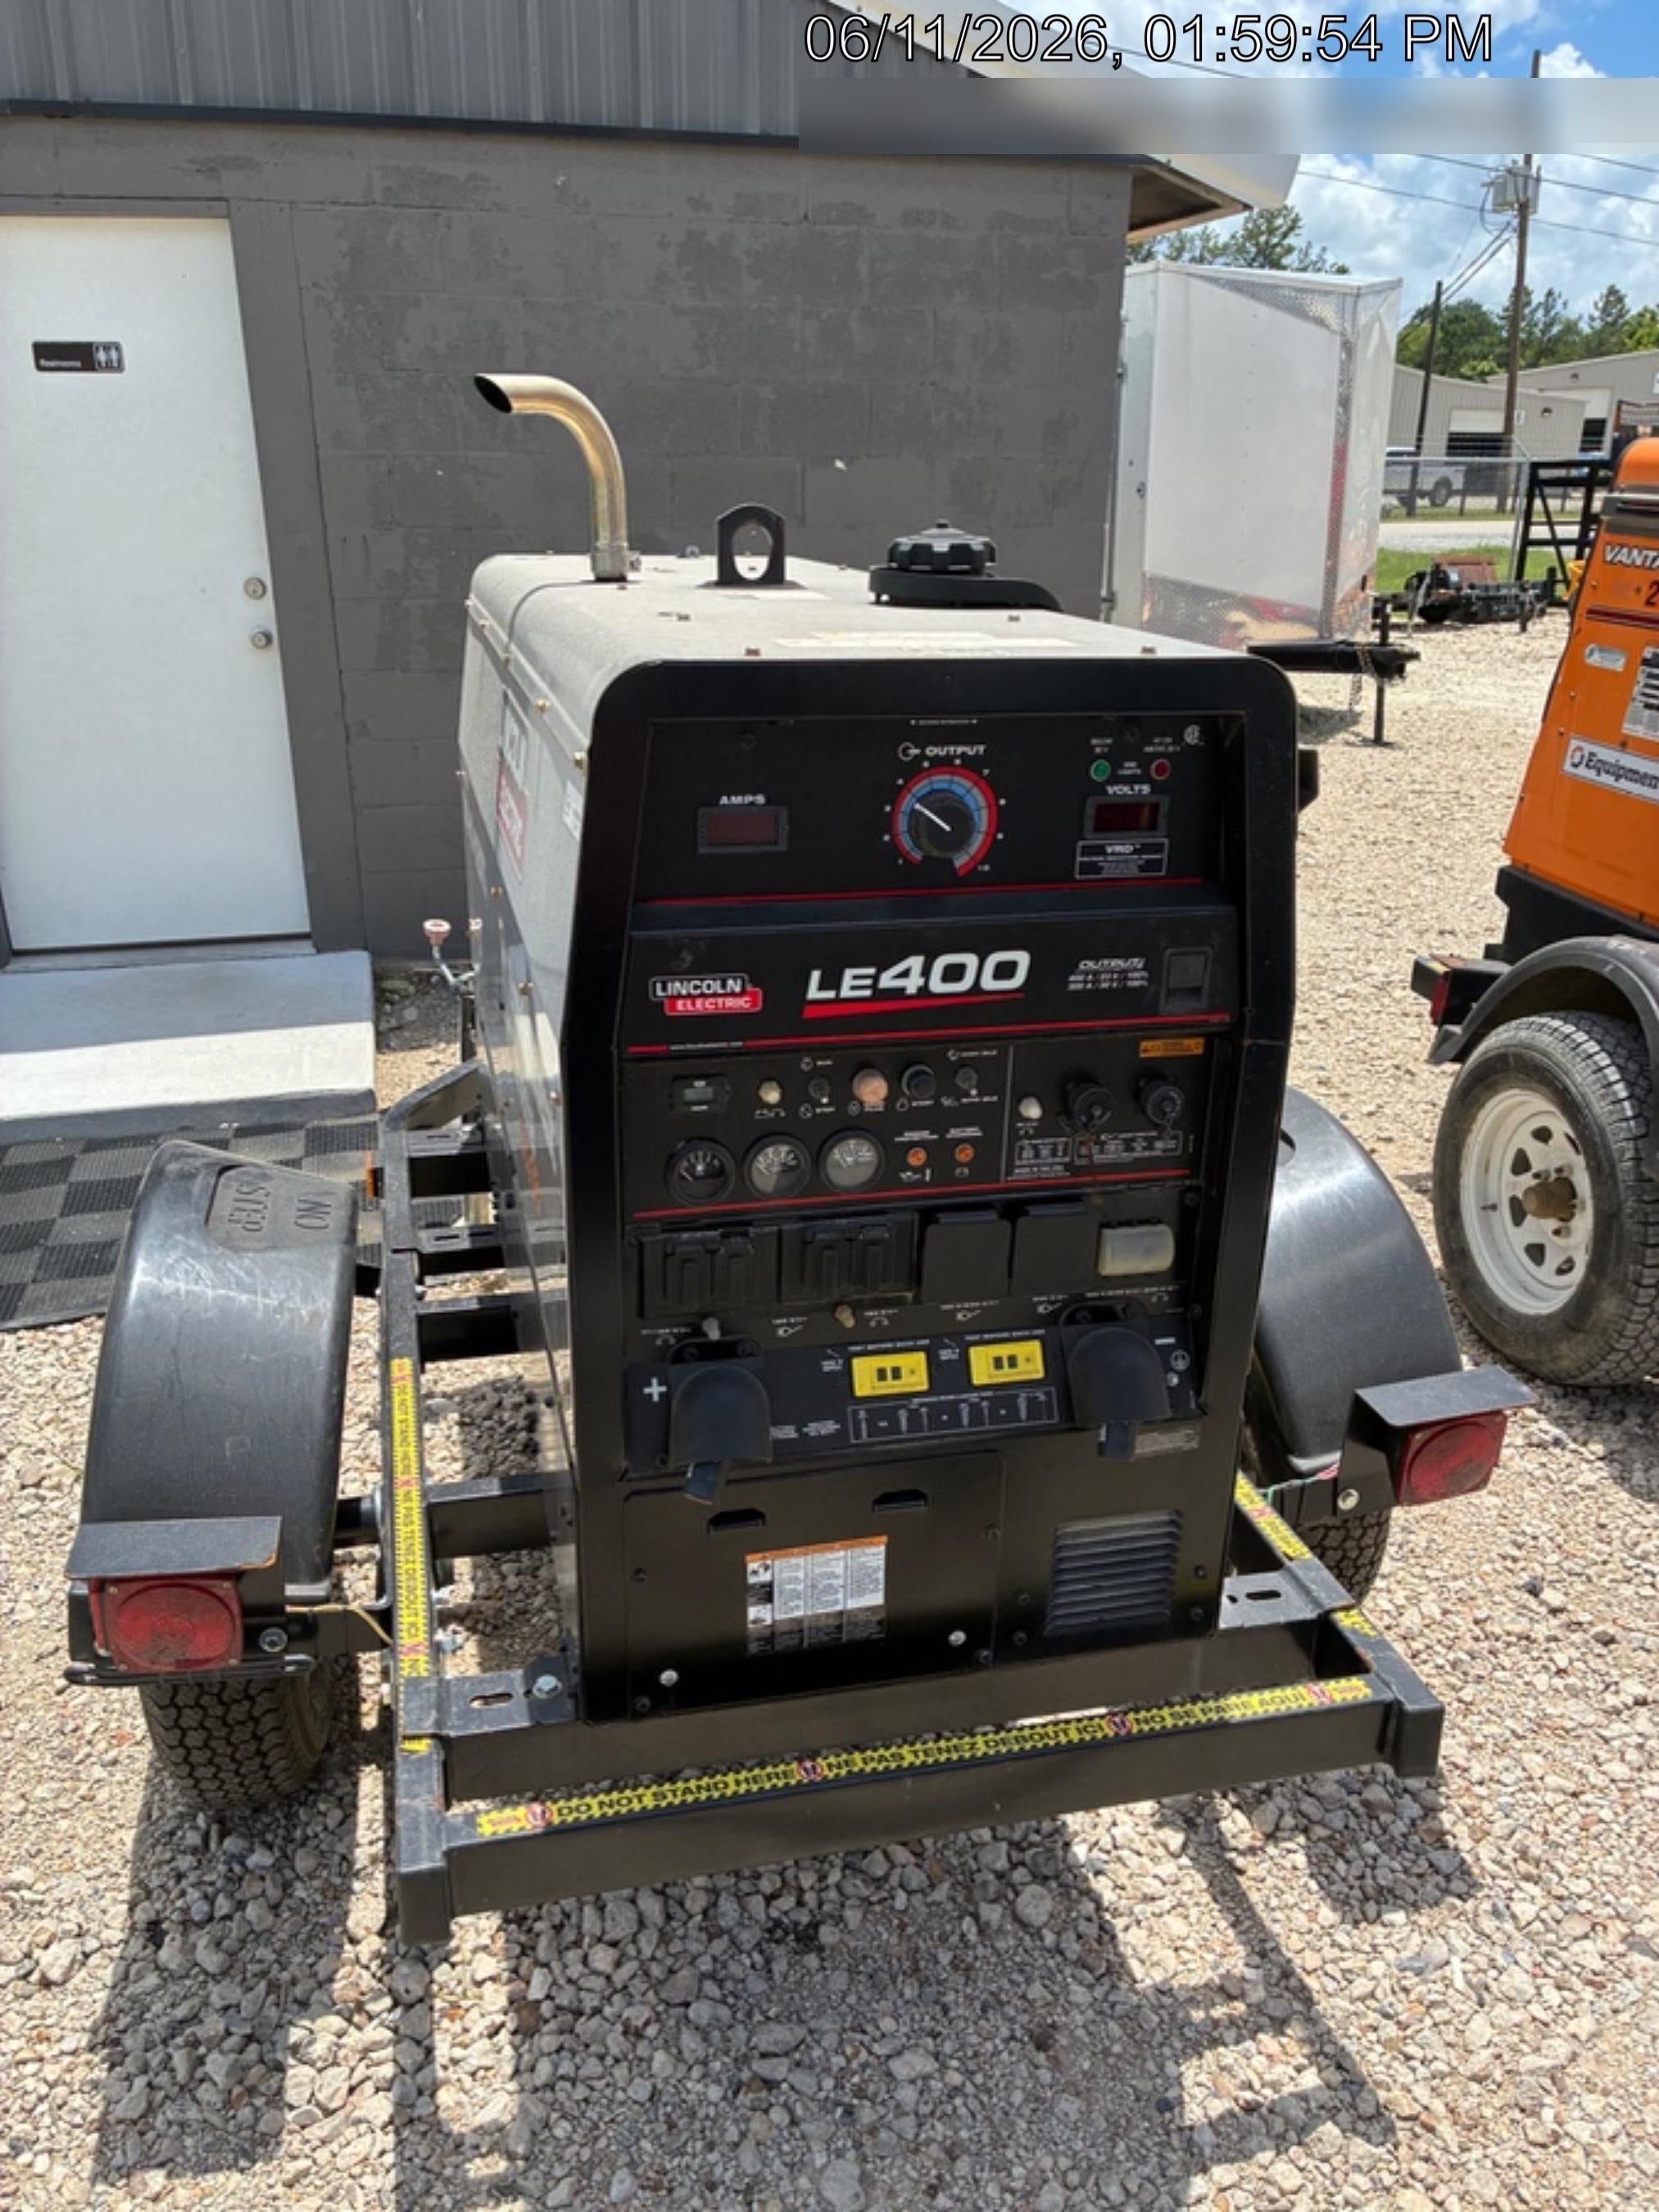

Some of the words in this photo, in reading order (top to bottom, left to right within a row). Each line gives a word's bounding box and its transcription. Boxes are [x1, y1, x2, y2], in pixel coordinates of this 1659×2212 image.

[925, 744, 987, 757] OUTPUT
[1105, 783, 1151, 795] VOLTS
[719, 793, 766, 805] AMPS
[805, 950, 1031, 1001] LE400
[655, 977, 743, 997] LINCOLN
[676, 996, 752, 1012] ELECTRIC
[557, 1802, 591, 1819] DO
[597, 1793, 645, 1811] NOT
[655, 1779, 731, 1802] STAND
[734, 1769, 795, 1788] HERE
[826, 1756, 853, 1774] NE
[860, 1751, 902, 1769] PAS
[908, 1740, 981, 1760] TENEZ
[983, 1728, 1072, 1752] DEBOUT
[1076, 1723, 1105, 1738] ICI
[1134, 1712, 1167, 1728] NO
